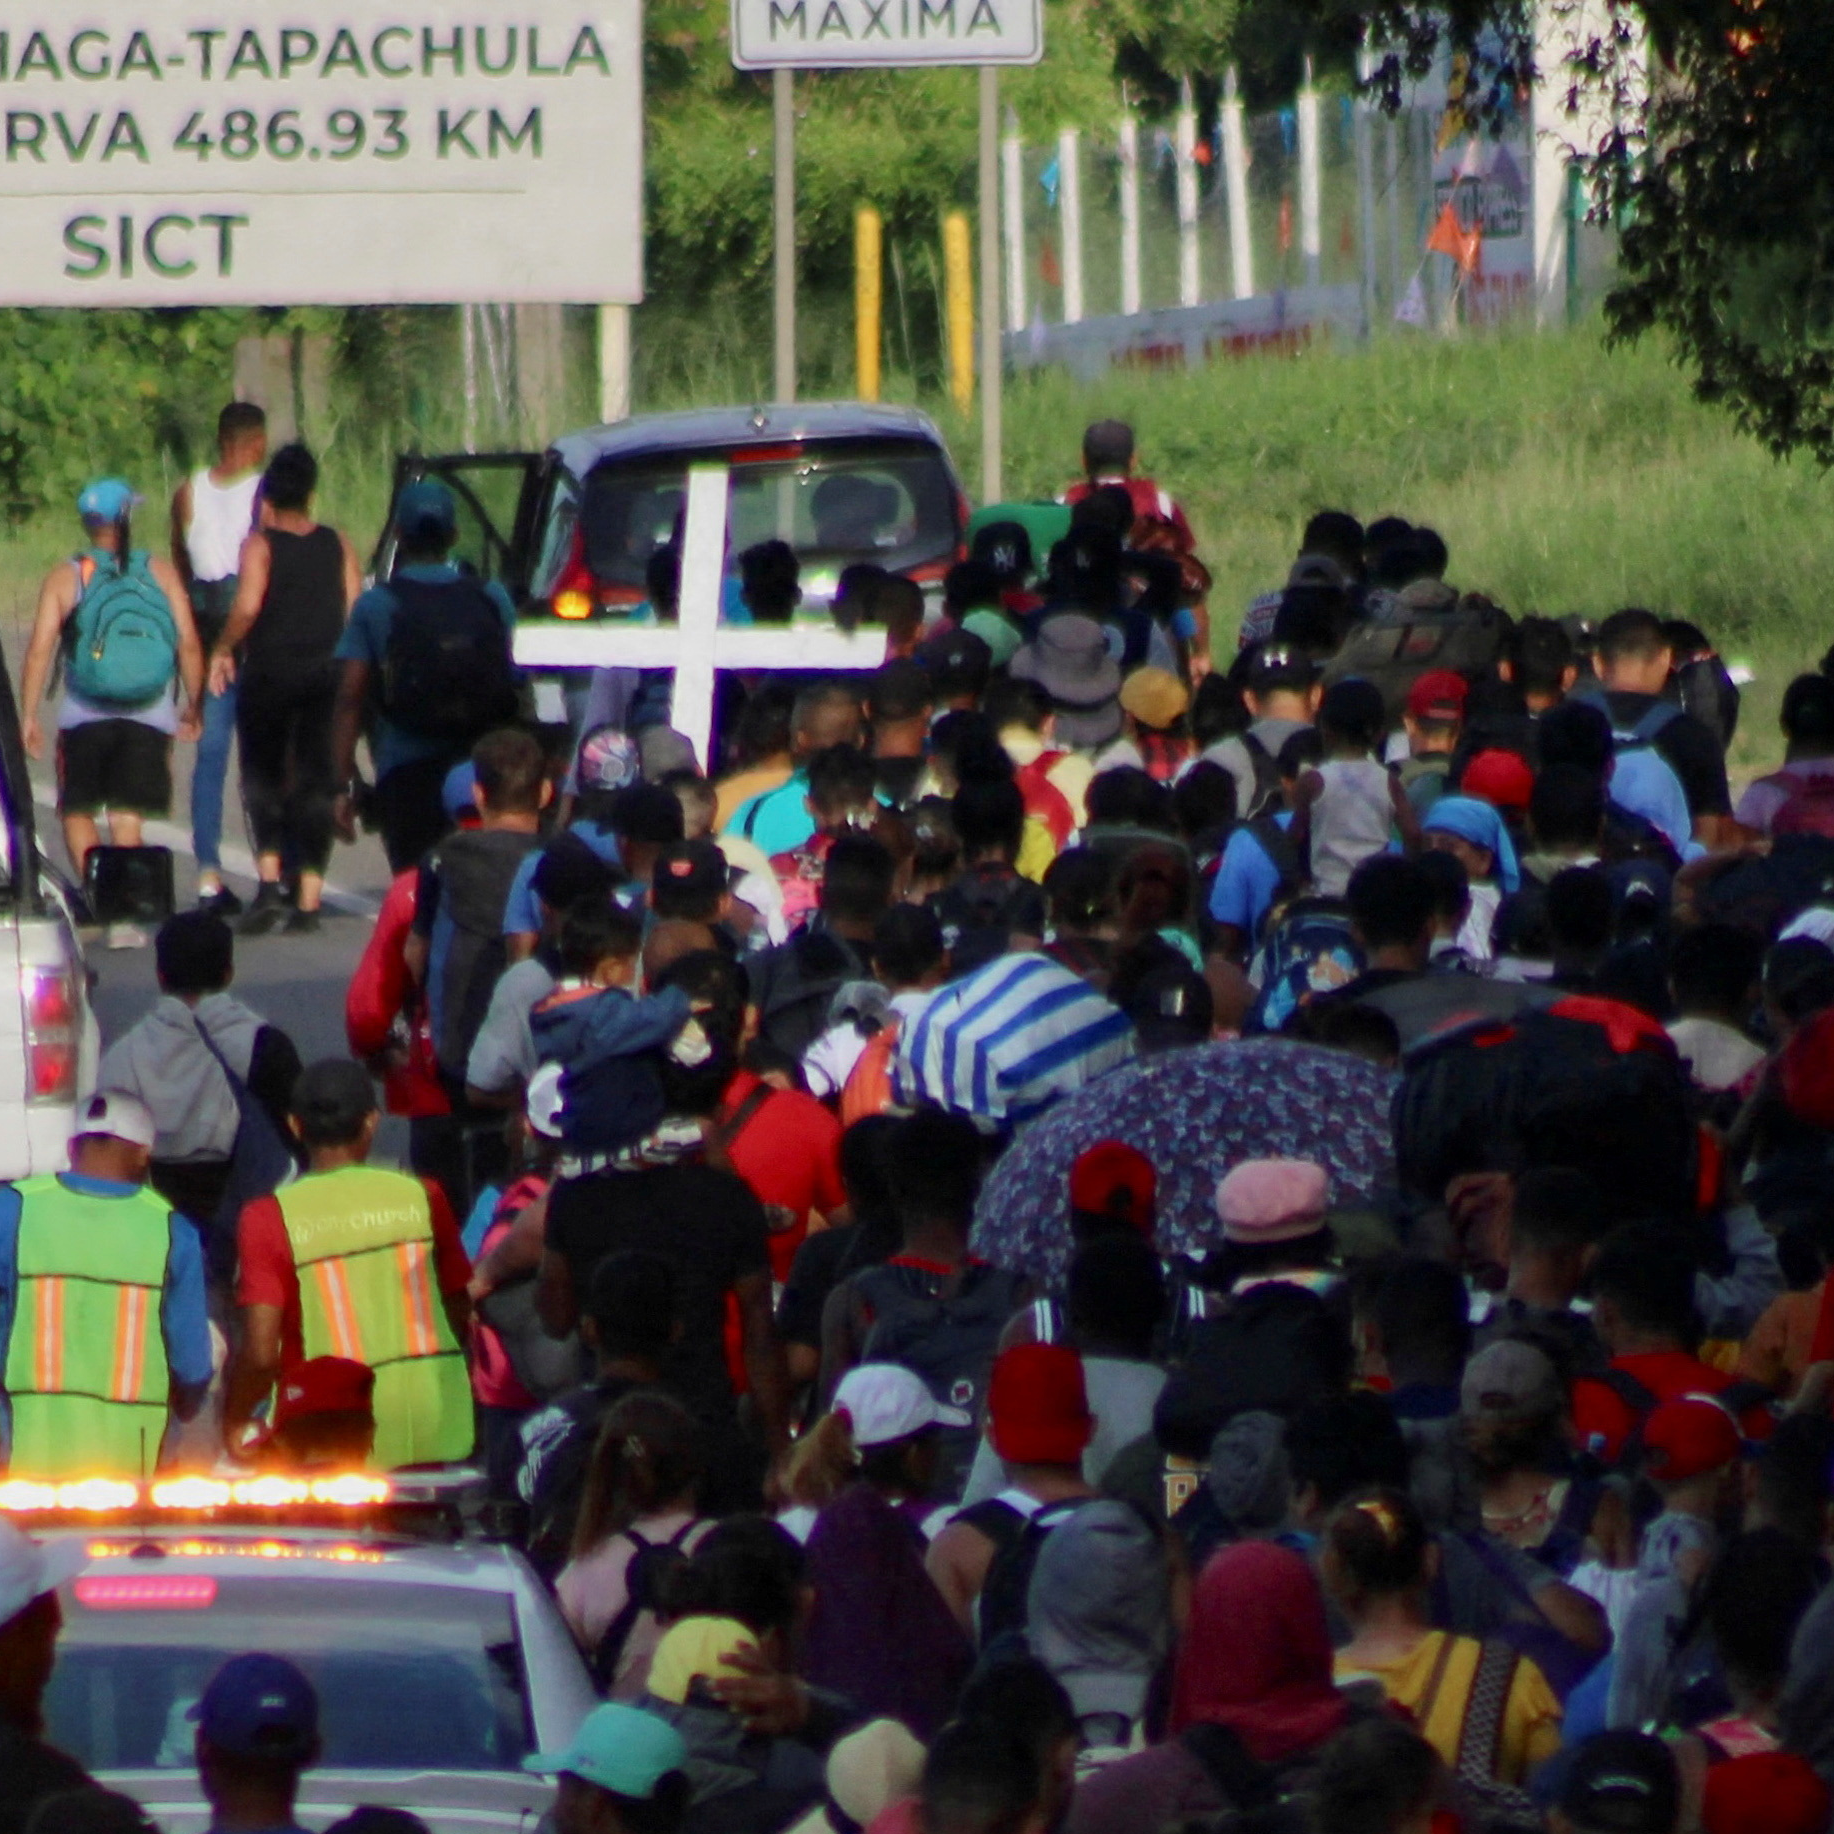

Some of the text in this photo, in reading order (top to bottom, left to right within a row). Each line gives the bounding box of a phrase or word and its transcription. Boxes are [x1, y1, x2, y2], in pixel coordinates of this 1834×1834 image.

[769, 0, 1002, 41] MAXIMA
[173, 108, 410, 162] 486.93
[436, 107, 543, 159] KM
[63, 213, 249, 280] SICT
